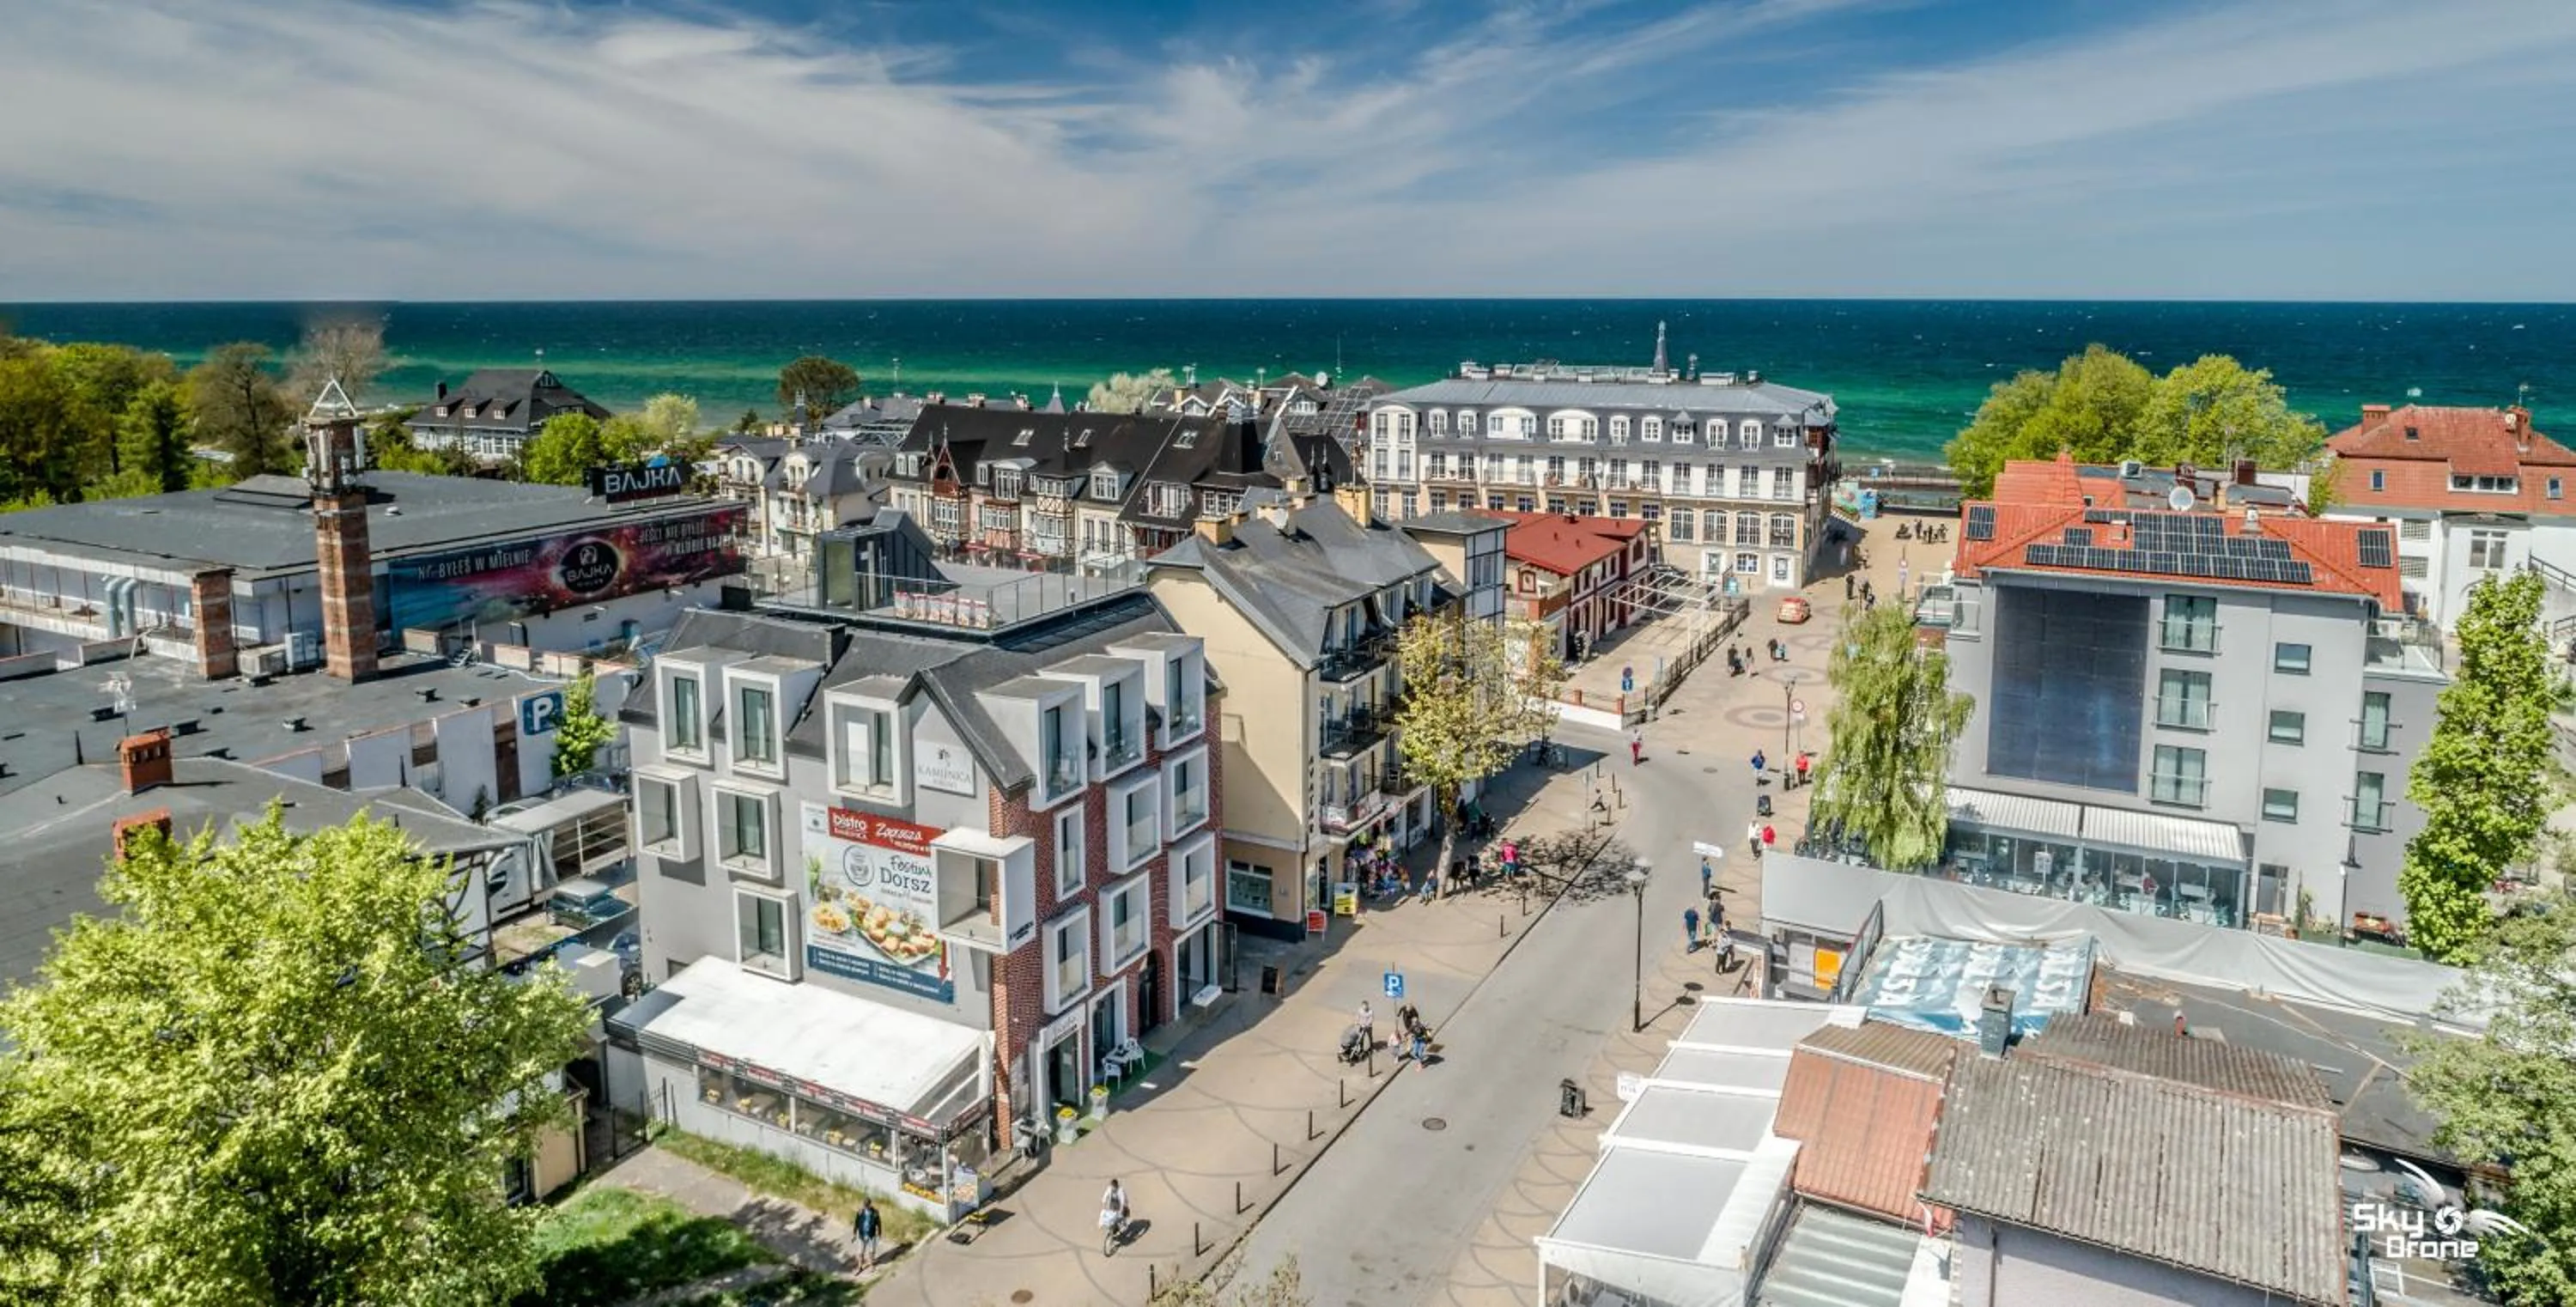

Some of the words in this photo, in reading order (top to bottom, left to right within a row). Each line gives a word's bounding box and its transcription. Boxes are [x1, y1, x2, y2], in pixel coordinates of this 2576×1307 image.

[605, 466, 681, 493] BAJKA
[475, 556, 485, 571] W
[532, 696, 554, 732] P
